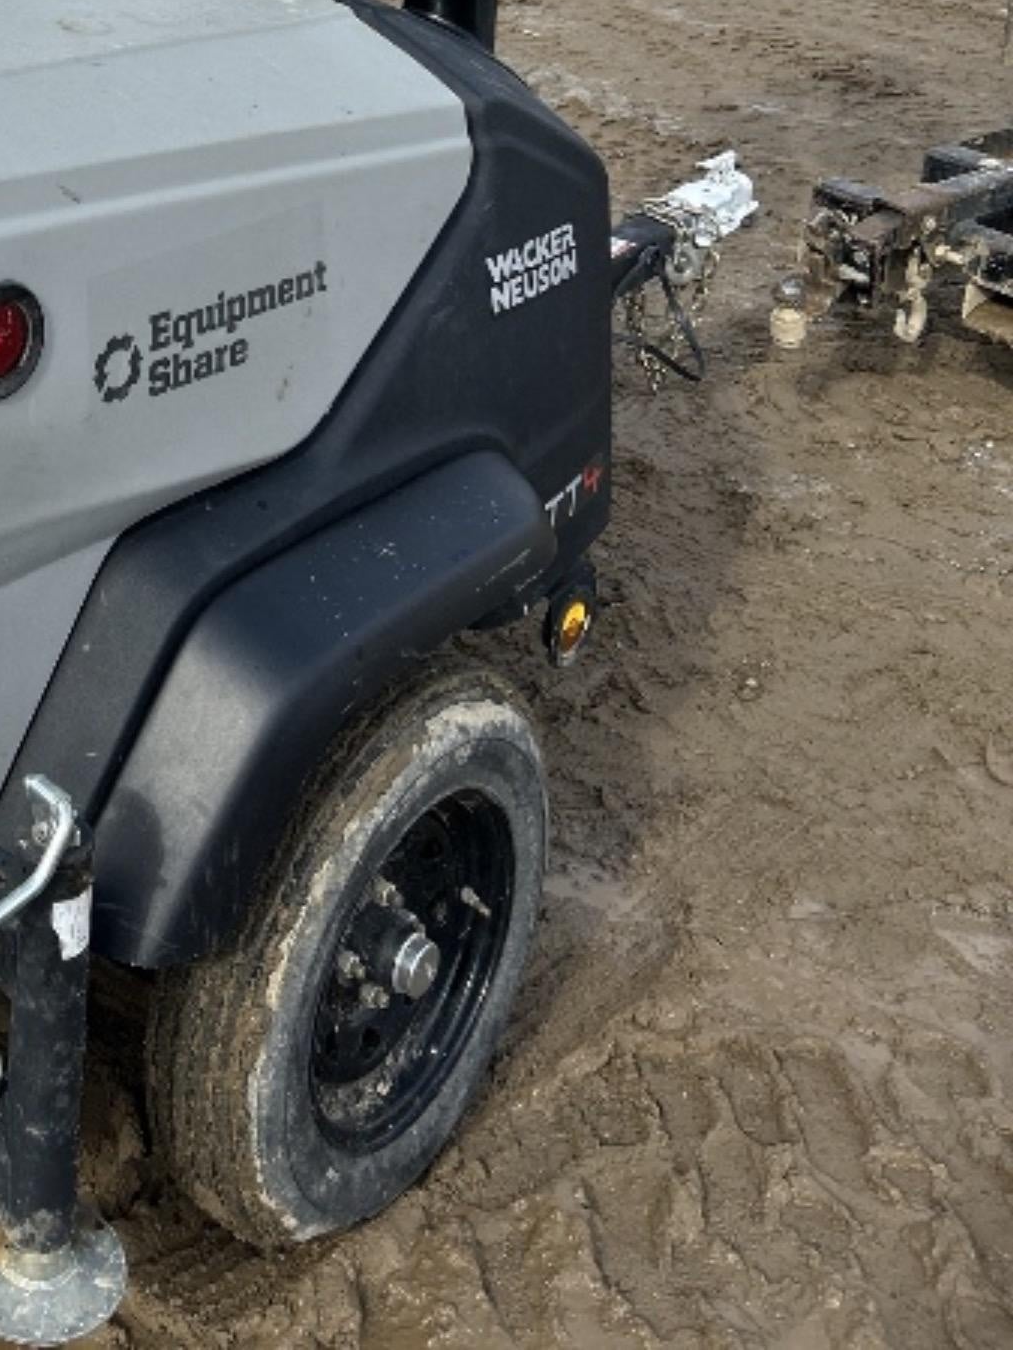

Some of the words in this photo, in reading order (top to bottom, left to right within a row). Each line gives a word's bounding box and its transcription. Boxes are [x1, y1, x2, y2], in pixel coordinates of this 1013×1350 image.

[486, 222, 577, 283] WACKER
[490, 249, 579, 316] NEUSON
[148, 260, 329, 351] Equipment
[148, 336, 249, 398] Share
